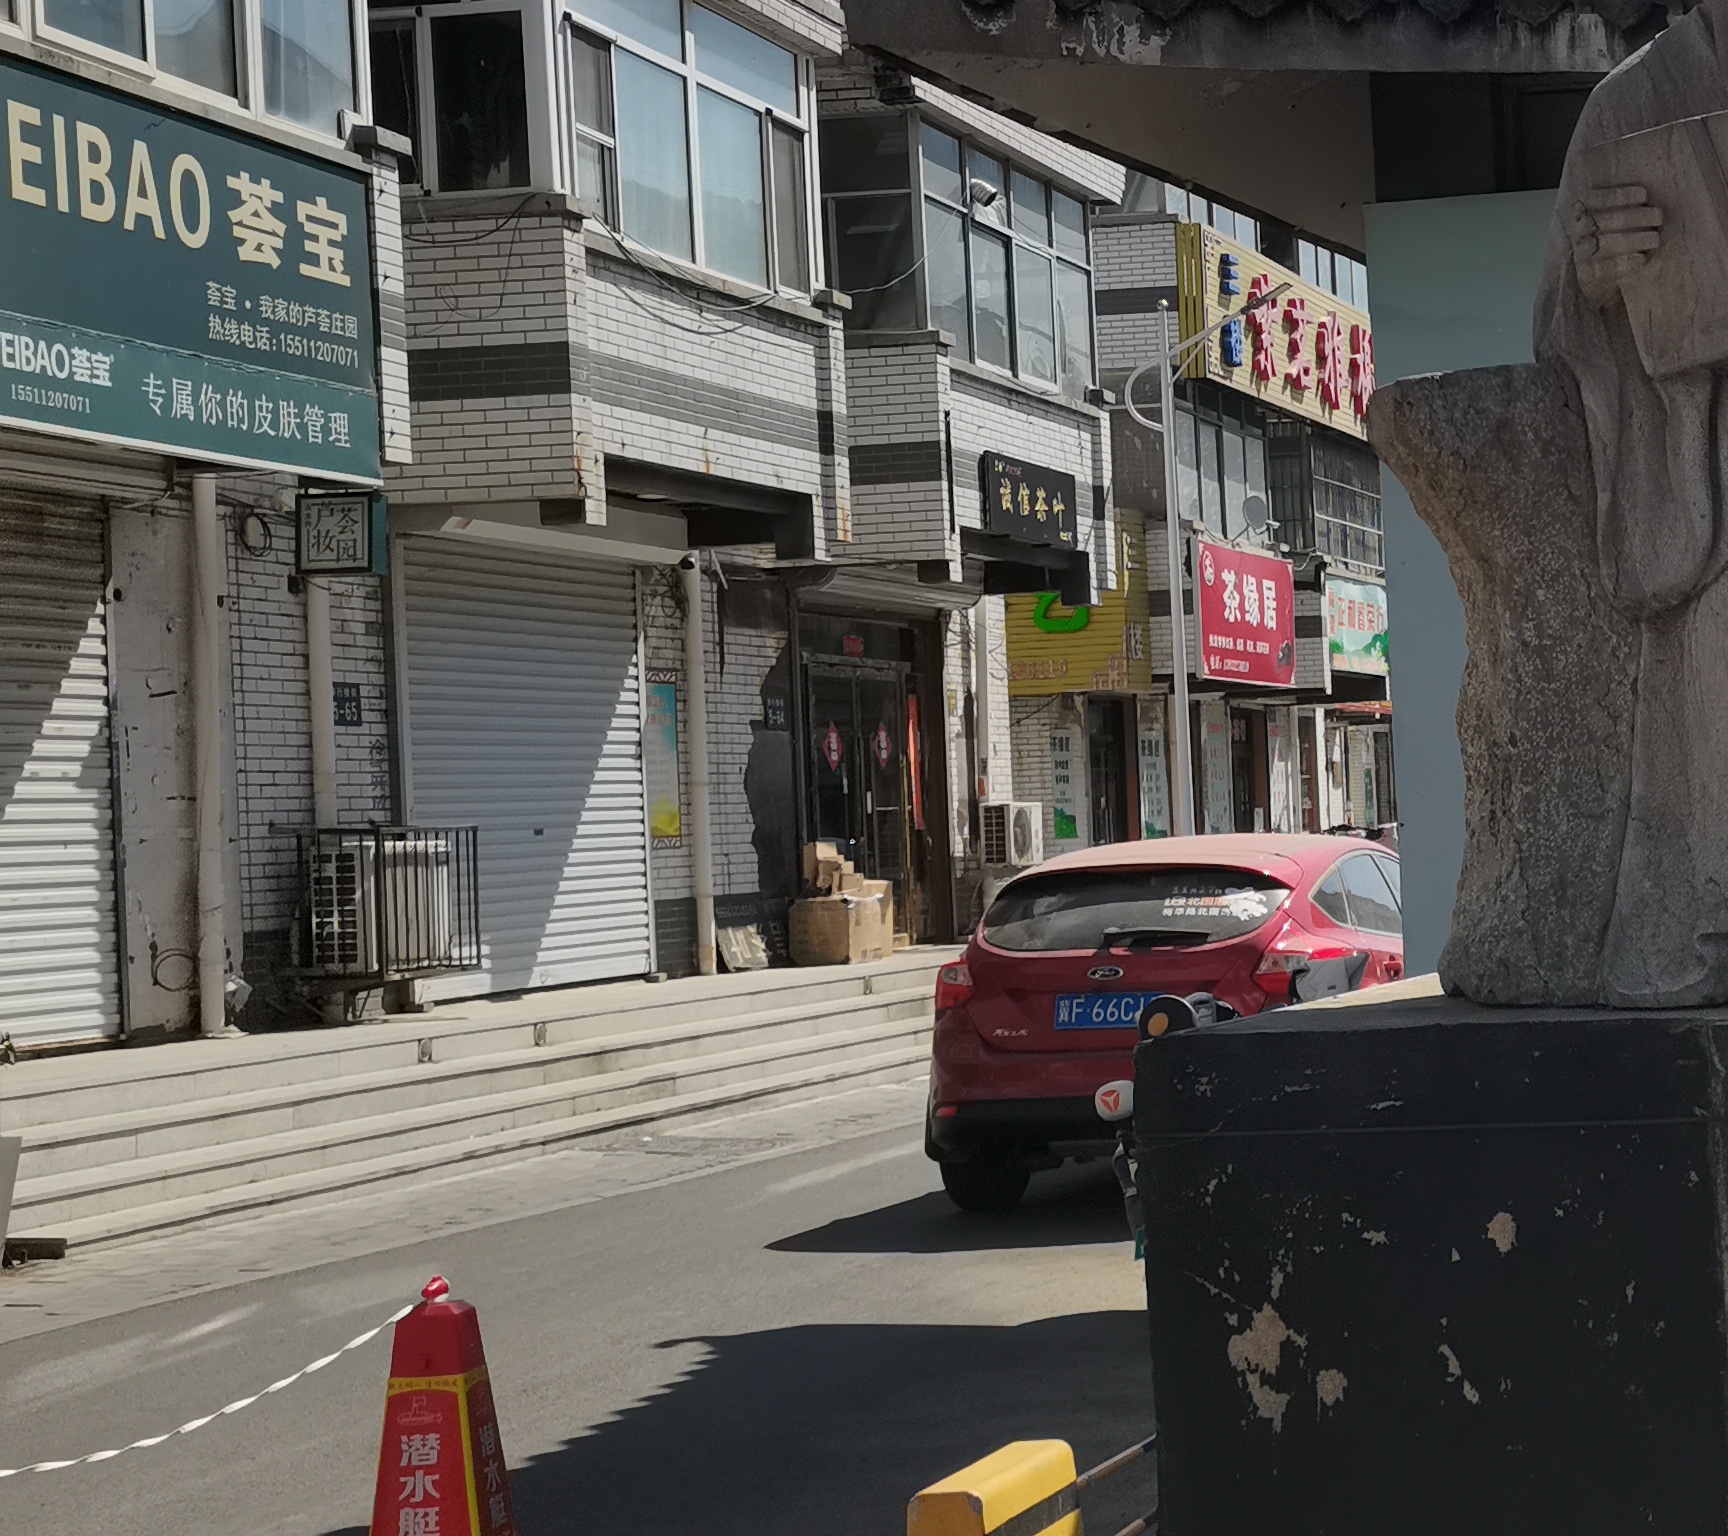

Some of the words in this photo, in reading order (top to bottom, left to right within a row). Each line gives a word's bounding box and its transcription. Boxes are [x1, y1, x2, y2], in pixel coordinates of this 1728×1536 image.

[226, 170, 351, 287] 荟宝
[10, 382, 91, 414] 15511207071
[140, 371, 352, 448] 专属你的皮肤管理
[1221, 568, 1277, 632] 茶缘居
